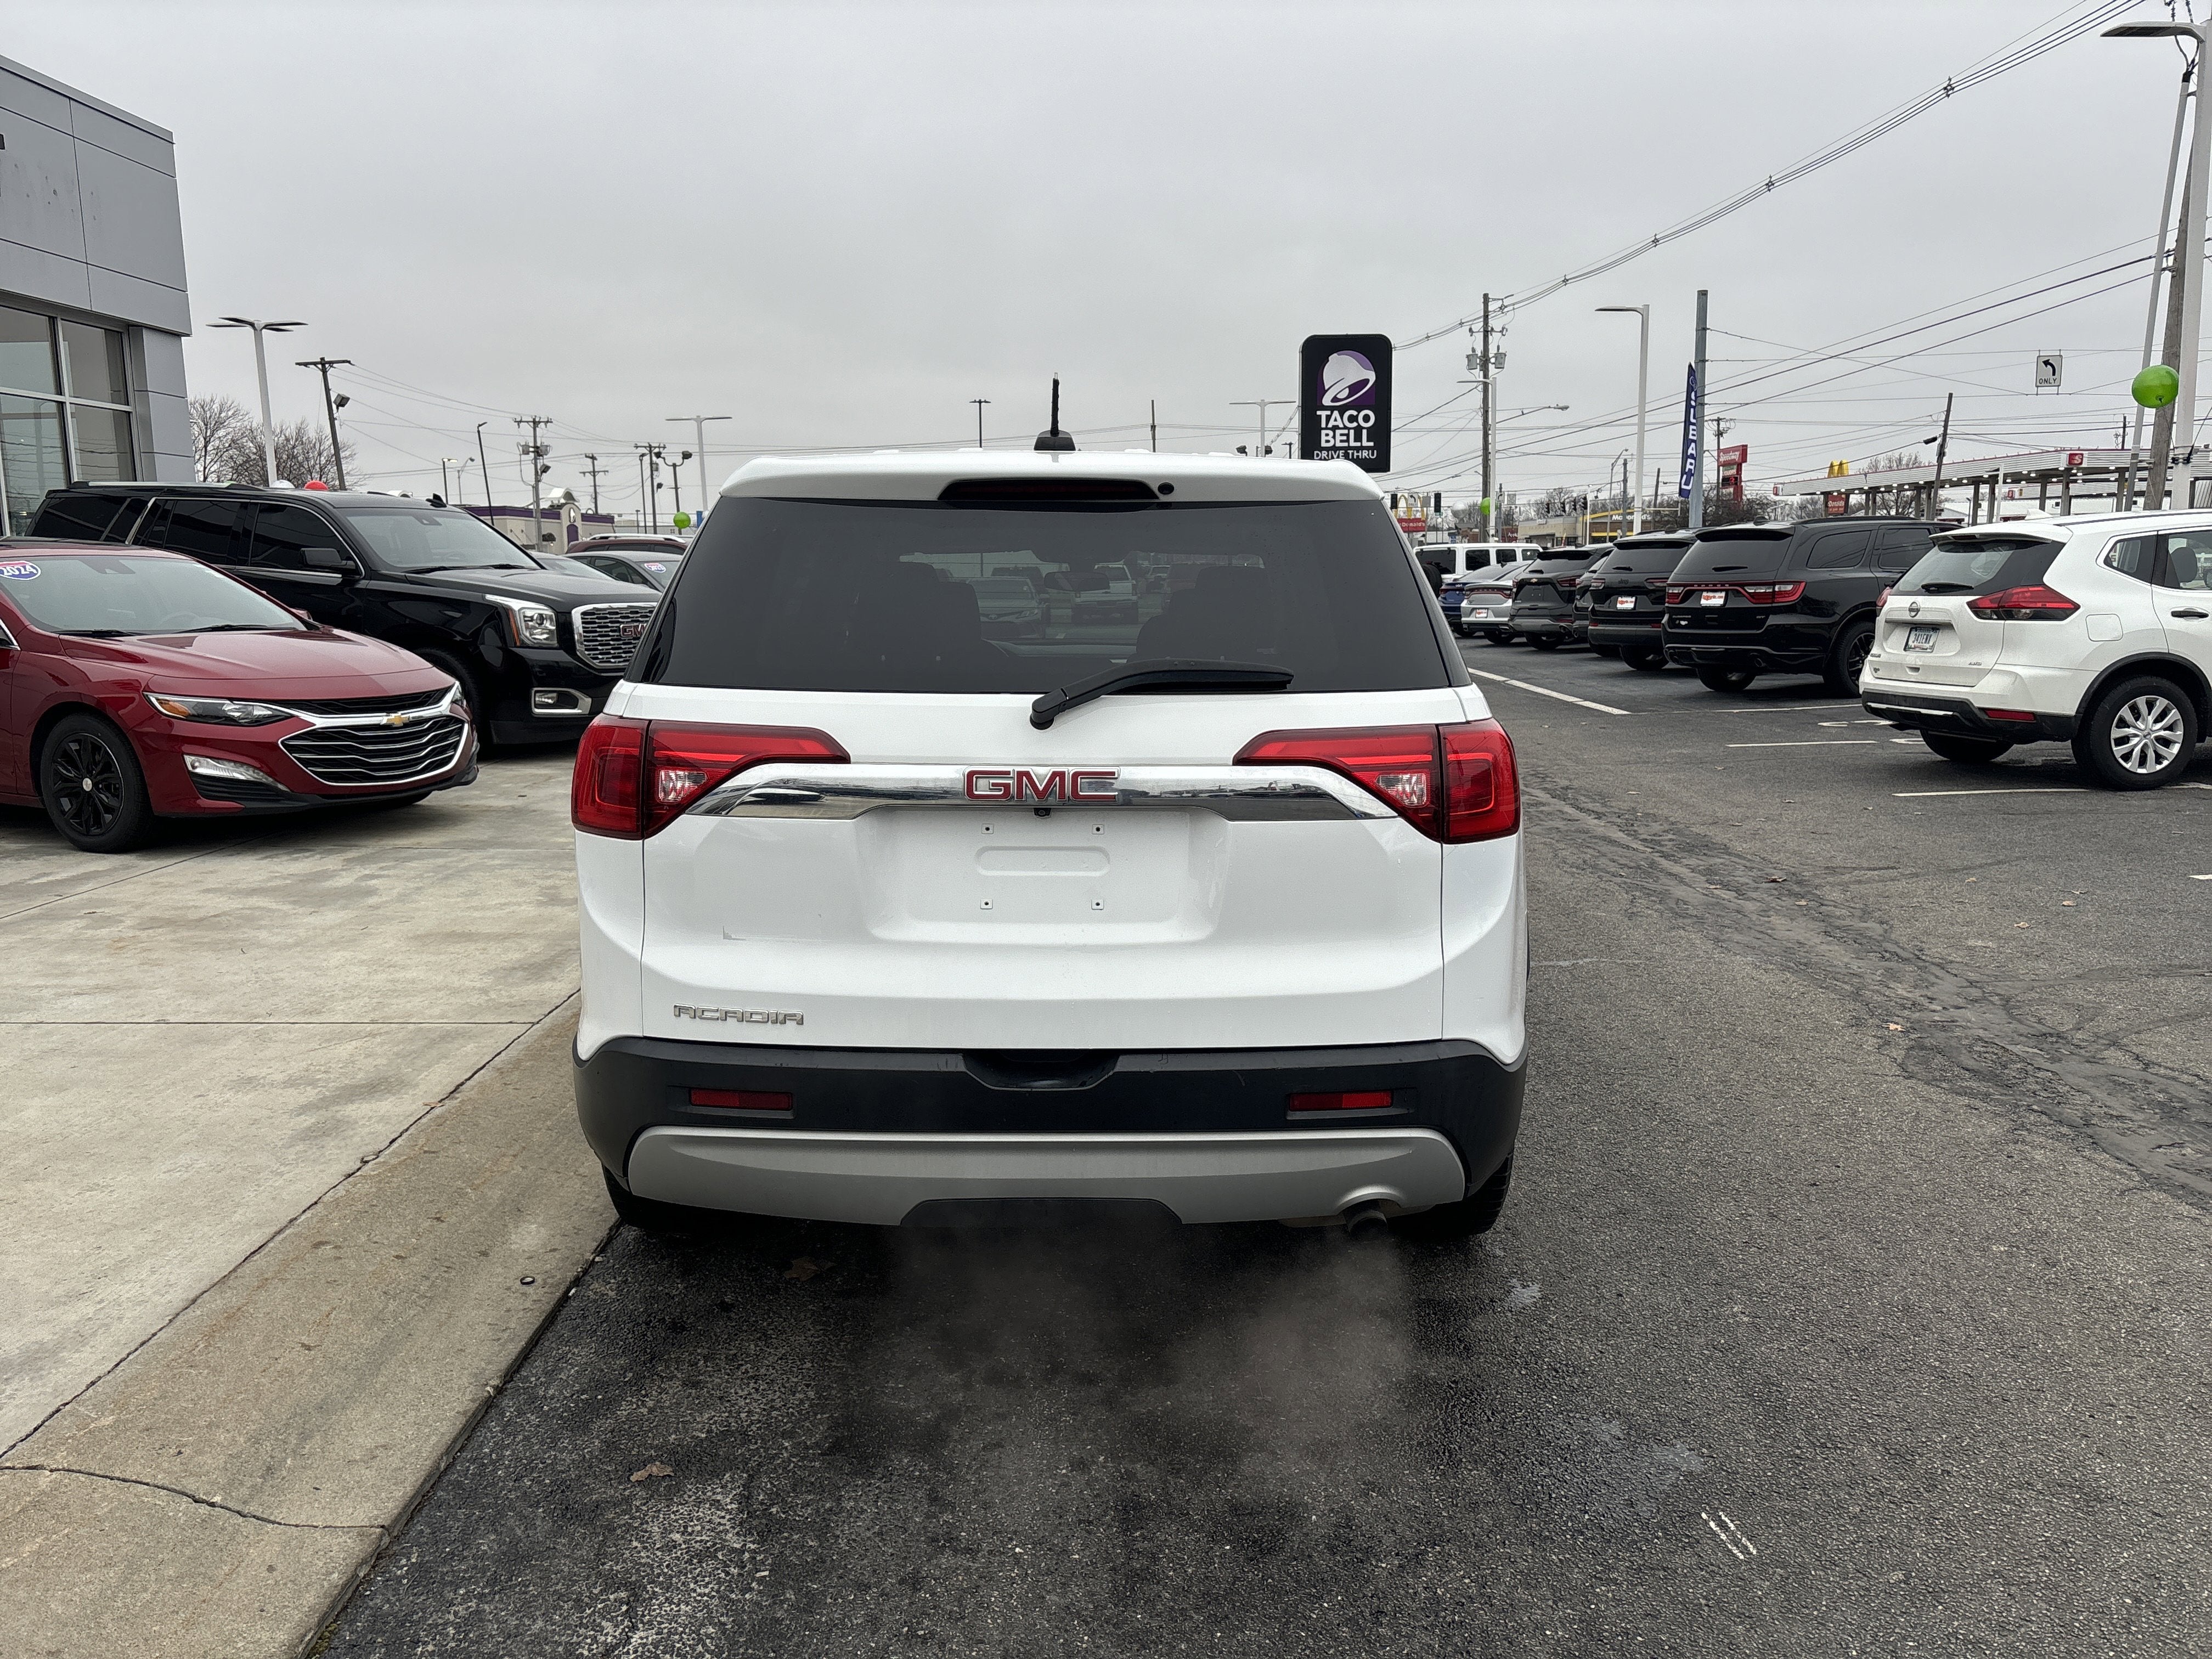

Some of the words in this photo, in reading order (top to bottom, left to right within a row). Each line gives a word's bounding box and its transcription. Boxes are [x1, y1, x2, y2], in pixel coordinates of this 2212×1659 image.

[1316, 409, 1375, 428] TACO
[1321, 428, 1374, 447] BELL
[1313, 450, 1345, 460] DRIVE
[1347, 450, 1377, 459] THRU
[0, 565, 38, 575] 2024
[620, 623, 647, 637] GM
[964, 766, 1120, 803] GMC
[673, 1003, 804, 1025] ACADIA
